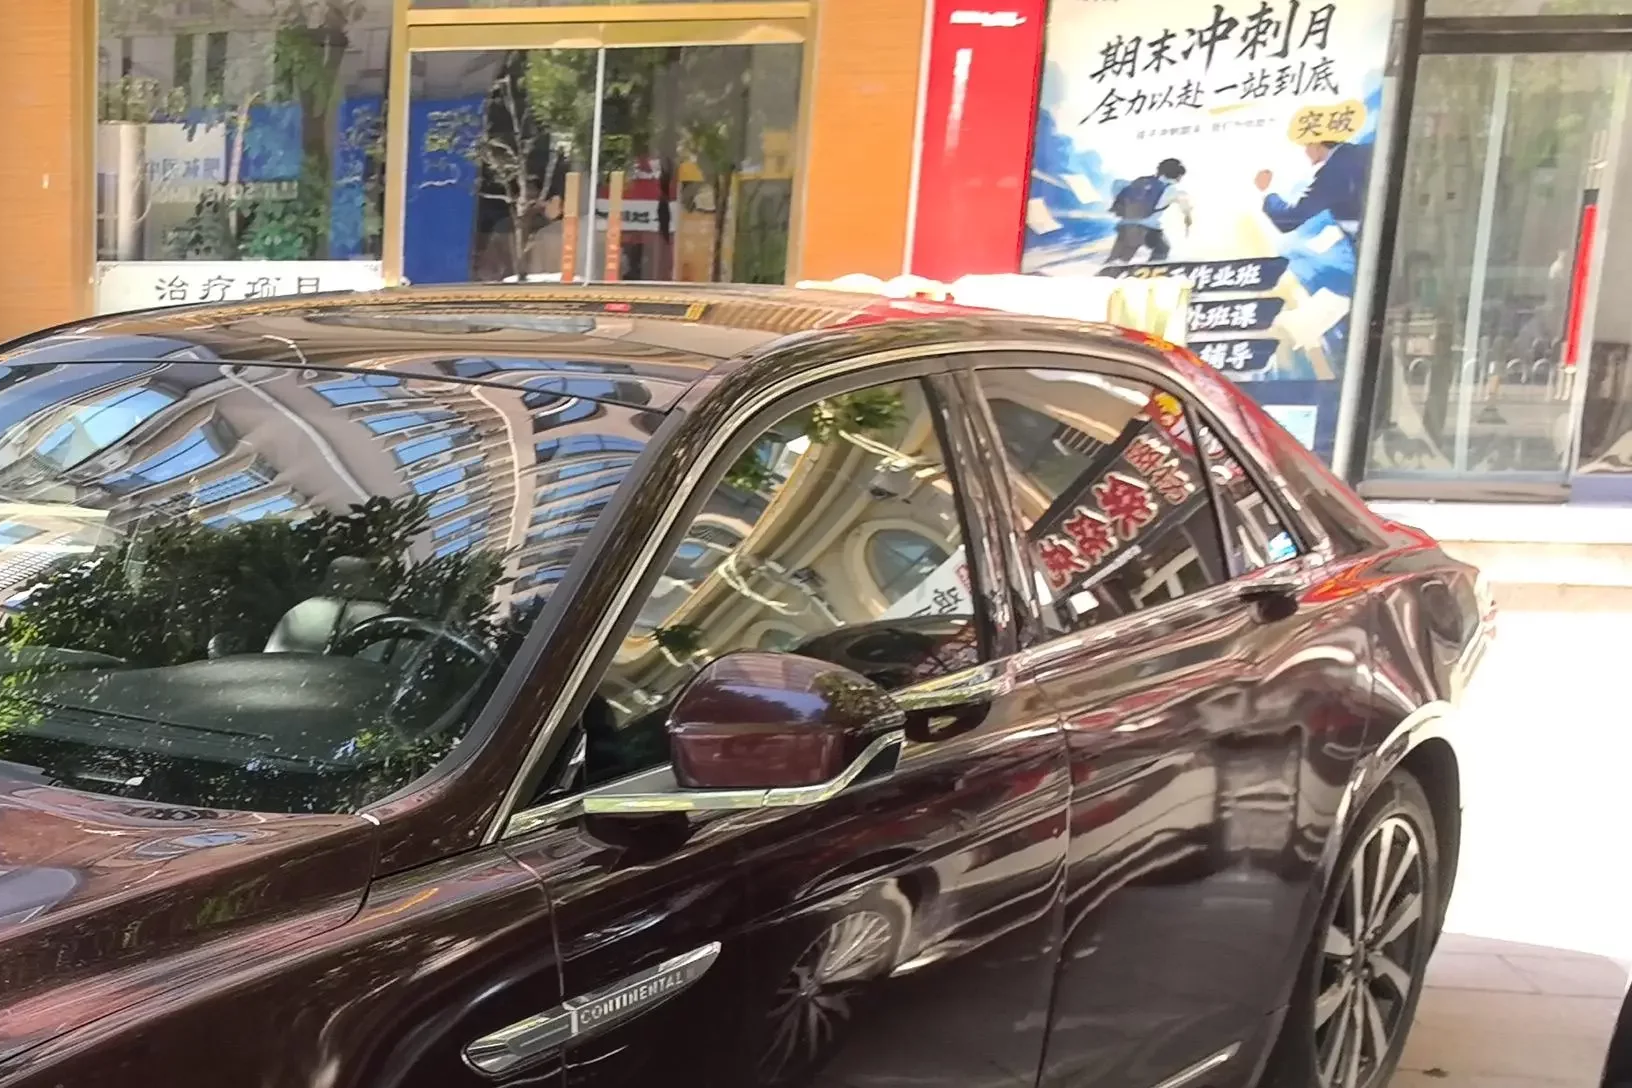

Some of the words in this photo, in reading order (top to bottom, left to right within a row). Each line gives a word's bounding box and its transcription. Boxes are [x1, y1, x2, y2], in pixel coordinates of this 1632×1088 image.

[1089, 1, 1336, 82] 期末冲刺月
[1079, 79, 1204, 126] 全力以赴
[1214, 56, 1339, 98] 一站到底
[1297, 105, 1356, 139] 突破
[154, 274, 320, 302] 治疗项目
[579, 971, 684, 1025] CONTINENTAL
